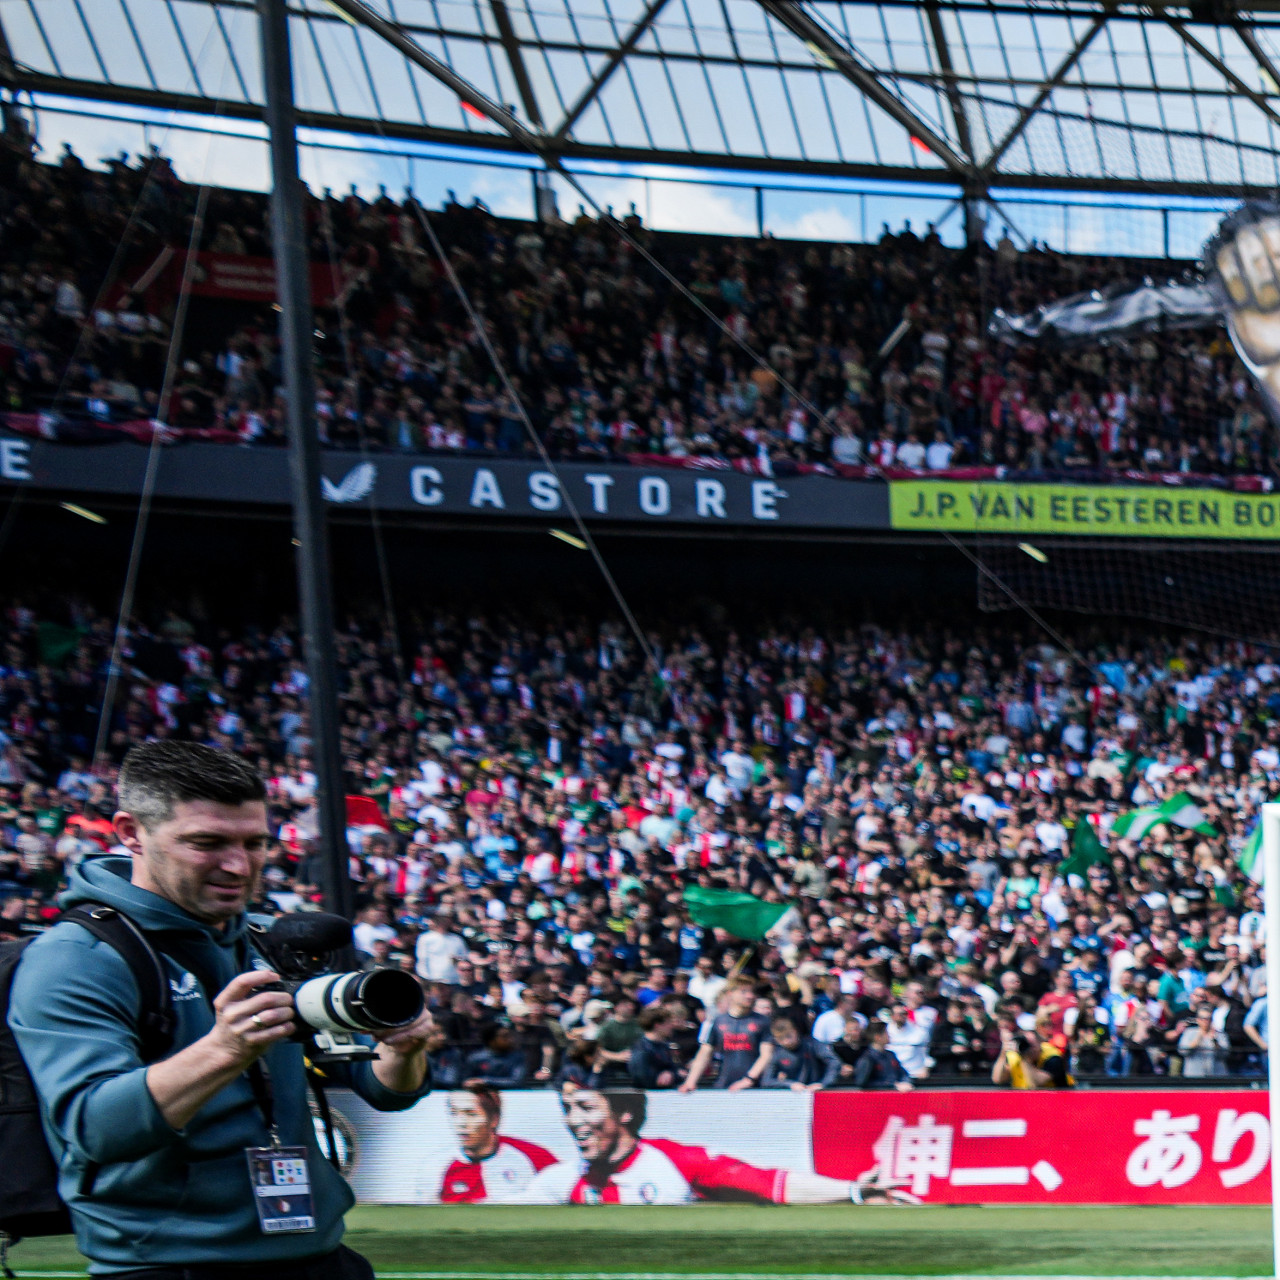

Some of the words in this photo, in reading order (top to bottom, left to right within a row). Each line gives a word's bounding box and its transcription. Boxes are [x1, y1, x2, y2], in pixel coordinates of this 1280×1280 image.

[410, 466, 781, 520] CASTORE
[910, 491, 960, 518] J.P.
[970, 493, 1035, 520] VAN
[1051, 496, 1220, 526] EESTEREN
